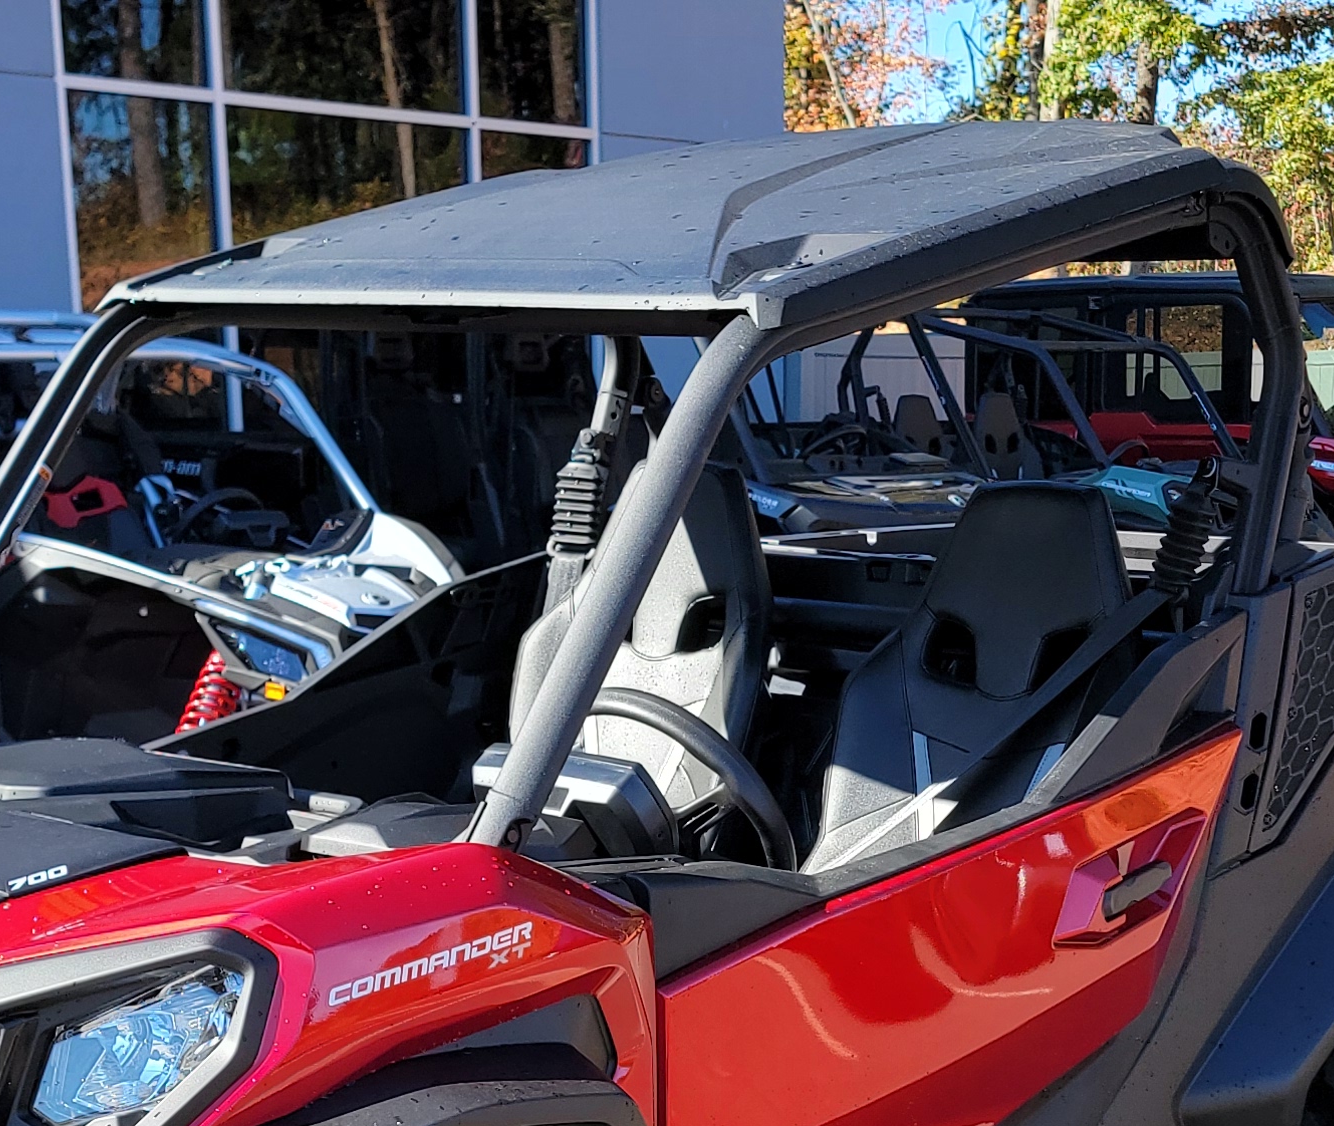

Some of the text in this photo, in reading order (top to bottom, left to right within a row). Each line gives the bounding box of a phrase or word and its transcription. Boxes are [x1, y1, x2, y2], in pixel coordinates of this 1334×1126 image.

[7, 864, 68, 891] 700
[328, 921, 534, 1007] COMMANDER
[487, 941, 532, 970] XT
